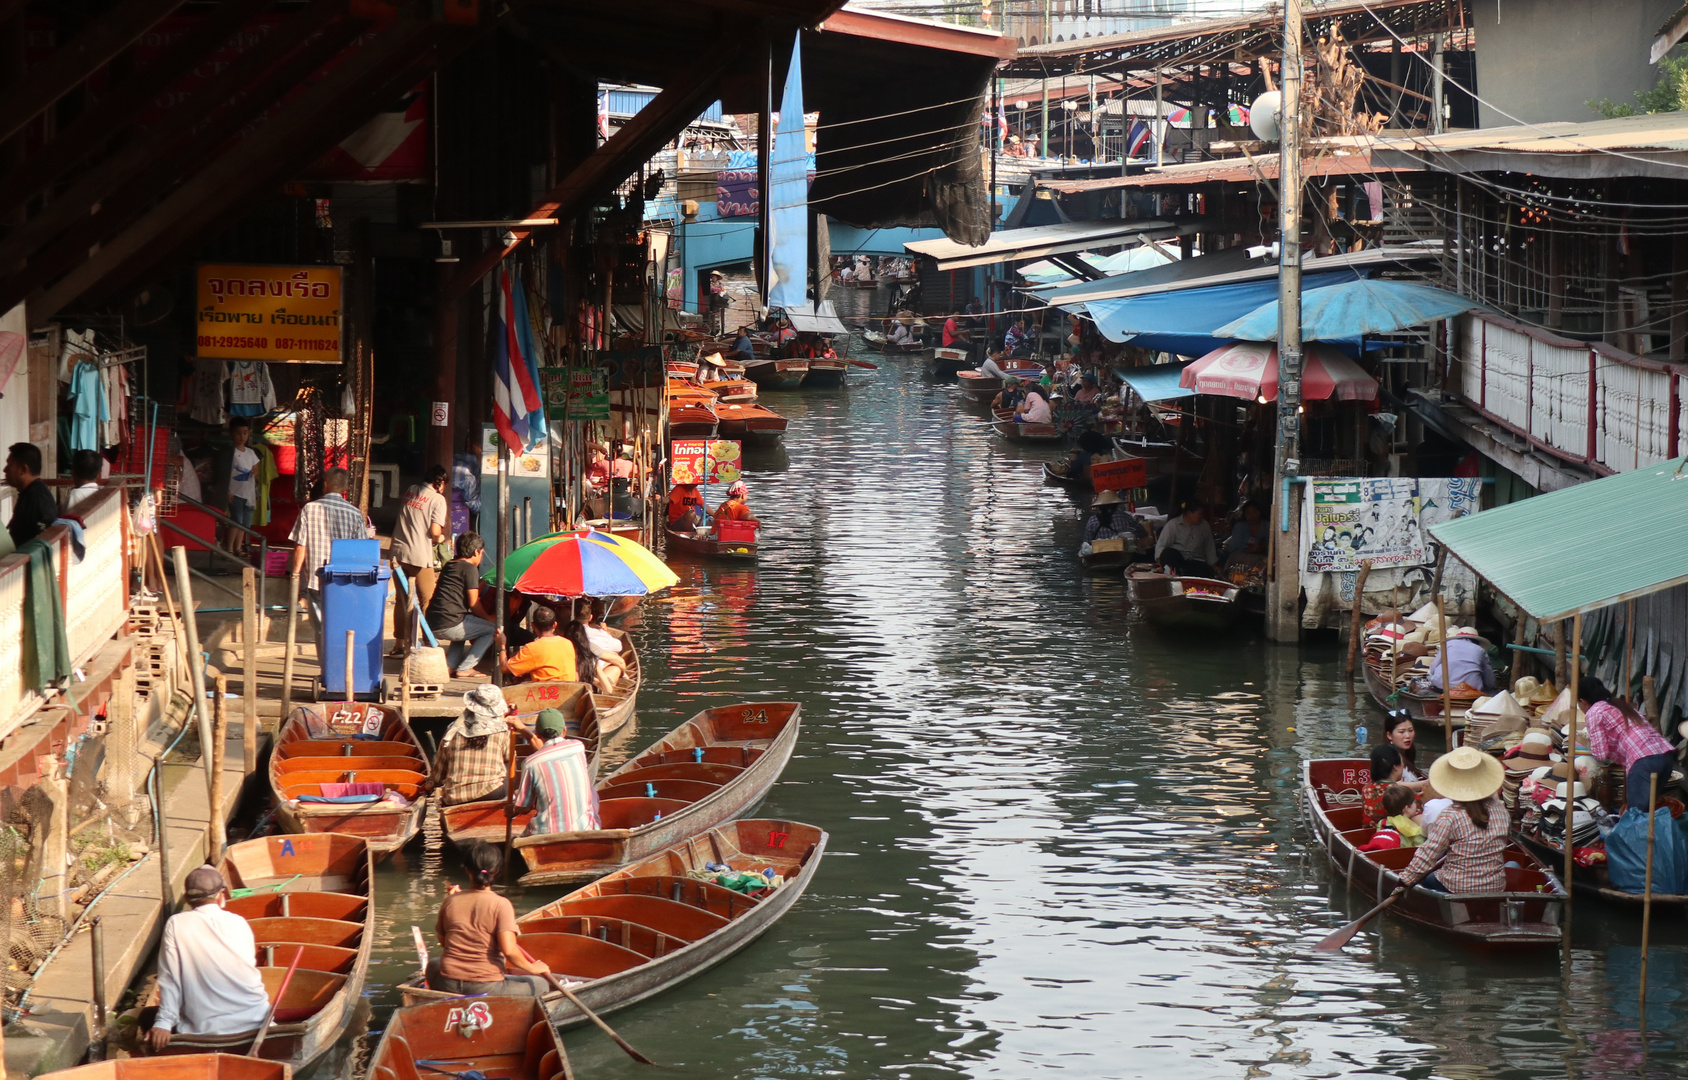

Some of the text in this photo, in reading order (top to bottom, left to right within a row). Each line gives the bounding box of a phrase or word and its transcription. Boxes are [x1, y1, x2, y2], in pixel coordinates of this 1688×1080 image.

[207, 270, 331, 304] จุดลงเรือ
[198, 305, 338, 327] เรือพาย เรือยนต์
[198, 335, 338, 351] 081-2925640 087-1111624
[741, 708, 769, 724] 24
[766, 831, 788, 848] 17
